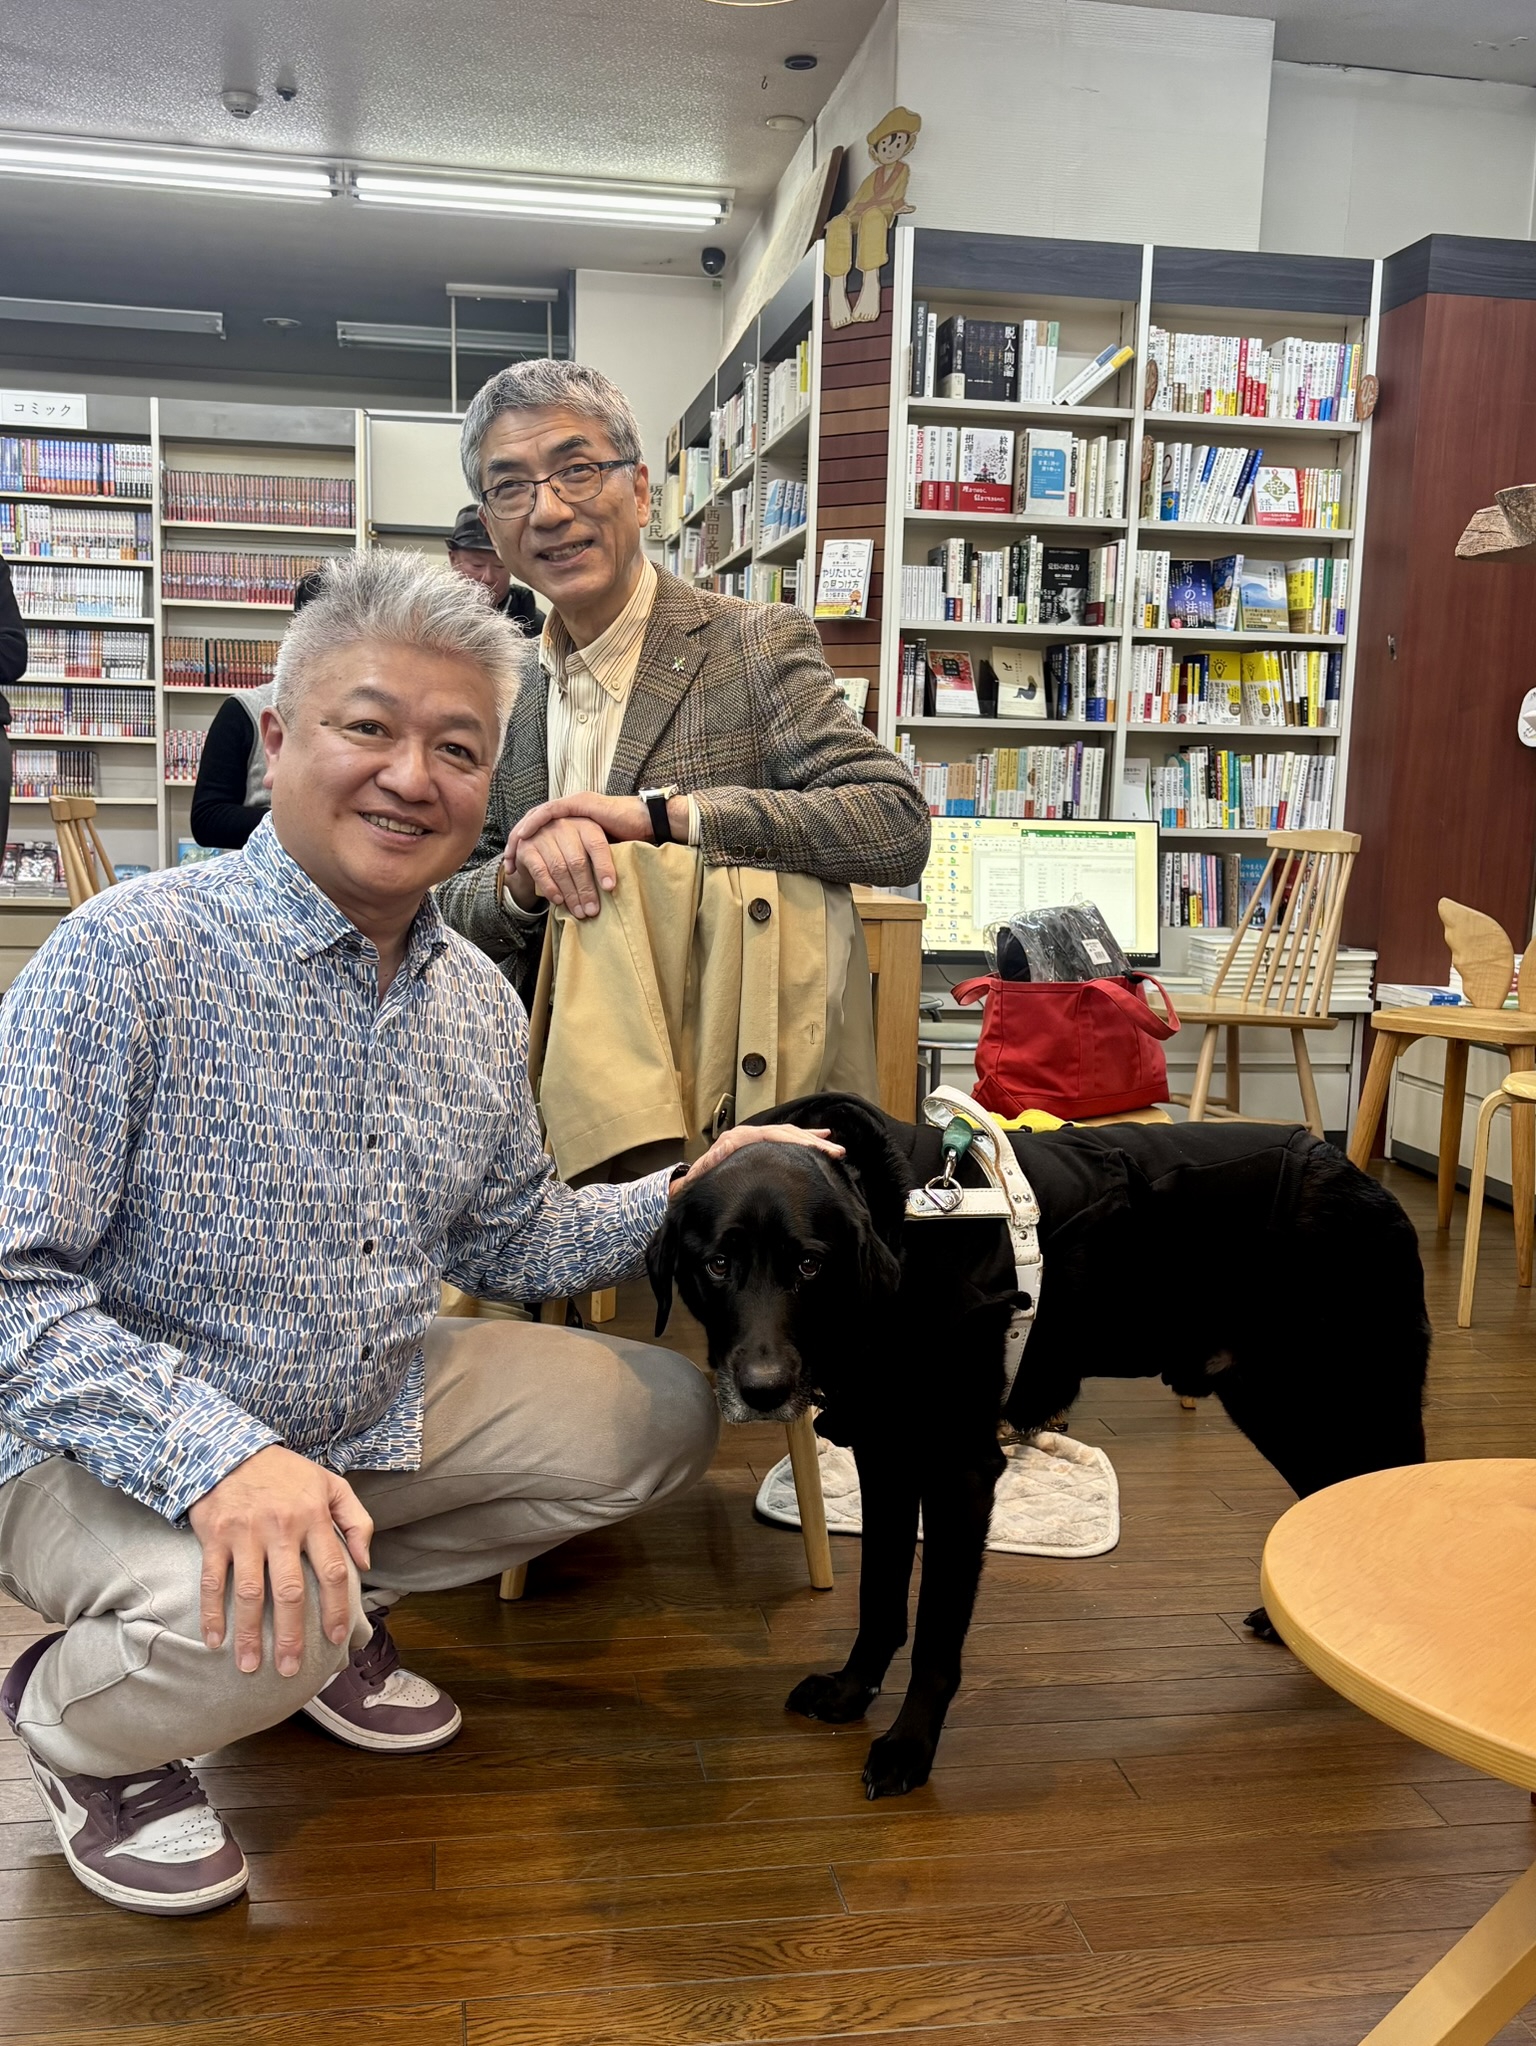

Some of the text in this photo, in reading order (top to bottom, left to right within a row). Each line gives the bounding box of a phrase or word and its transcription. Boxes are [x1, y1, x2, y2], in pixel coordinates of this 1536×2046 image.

[1003, 326, 1016, 378] 脱人間論
[14, 402, 71, 417] コミック
[648, 485, 664, 538] 坂村真民
[705, 509, 720, 567] 西田文郎
[822, 580, 860, 589] の見つけ方
[1183, 561, 1199, 628] 祈りの法則
